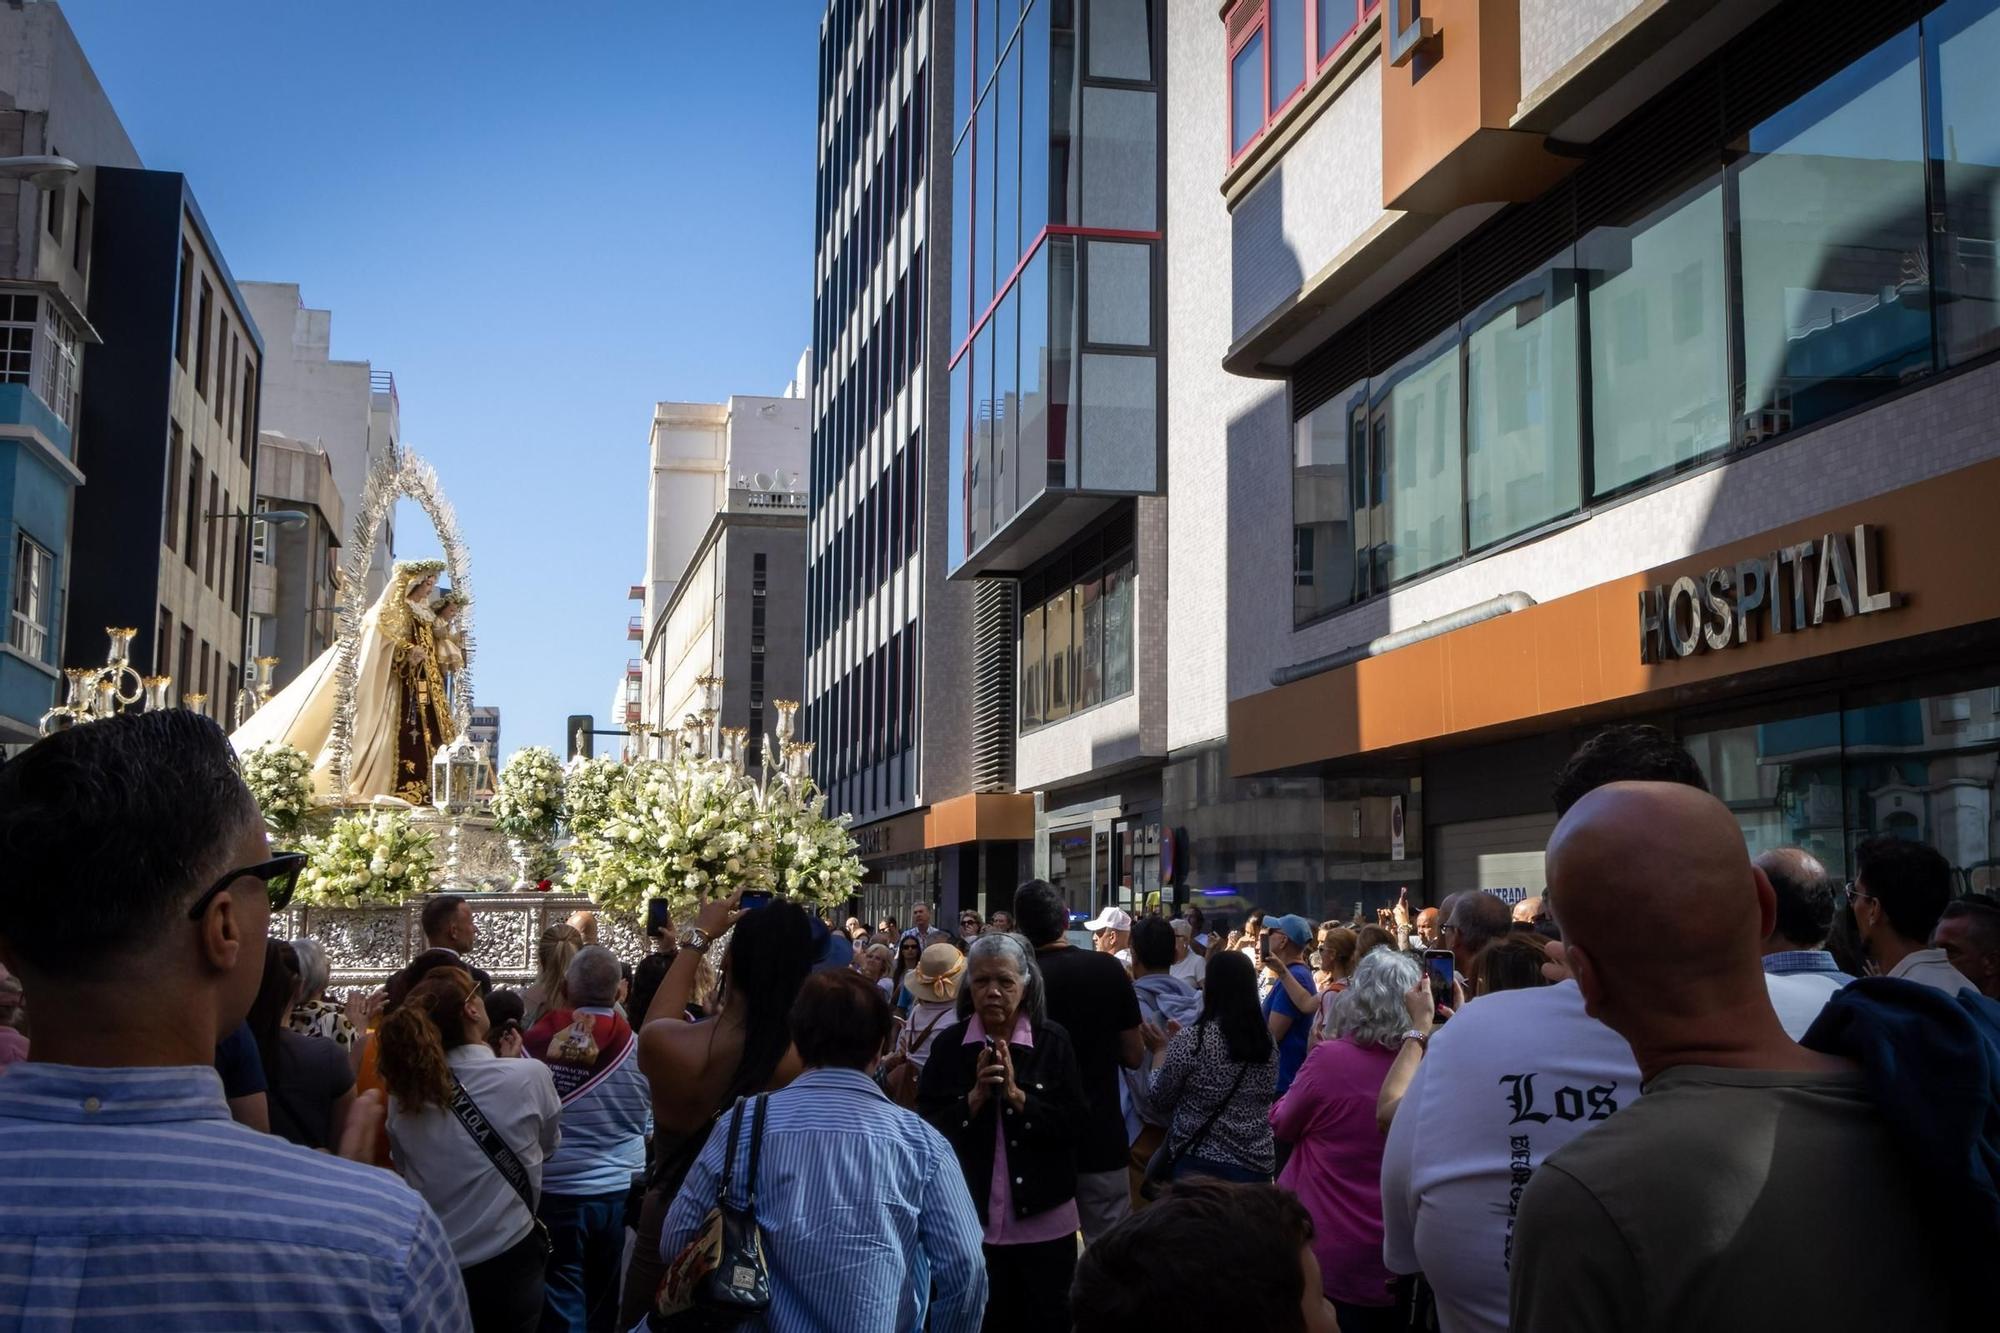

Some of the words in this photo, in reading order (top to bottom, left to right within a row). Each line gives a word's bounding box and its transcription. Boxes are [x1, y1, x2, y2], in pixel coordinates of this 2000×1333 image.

[1638, 523, 1902, 665] HOSPITAL
[1483, 887, 1528, 903] TRADA
[1499, 1073, 1618, 1125] Los
[460, 1107, 491, 1142] LOLA
